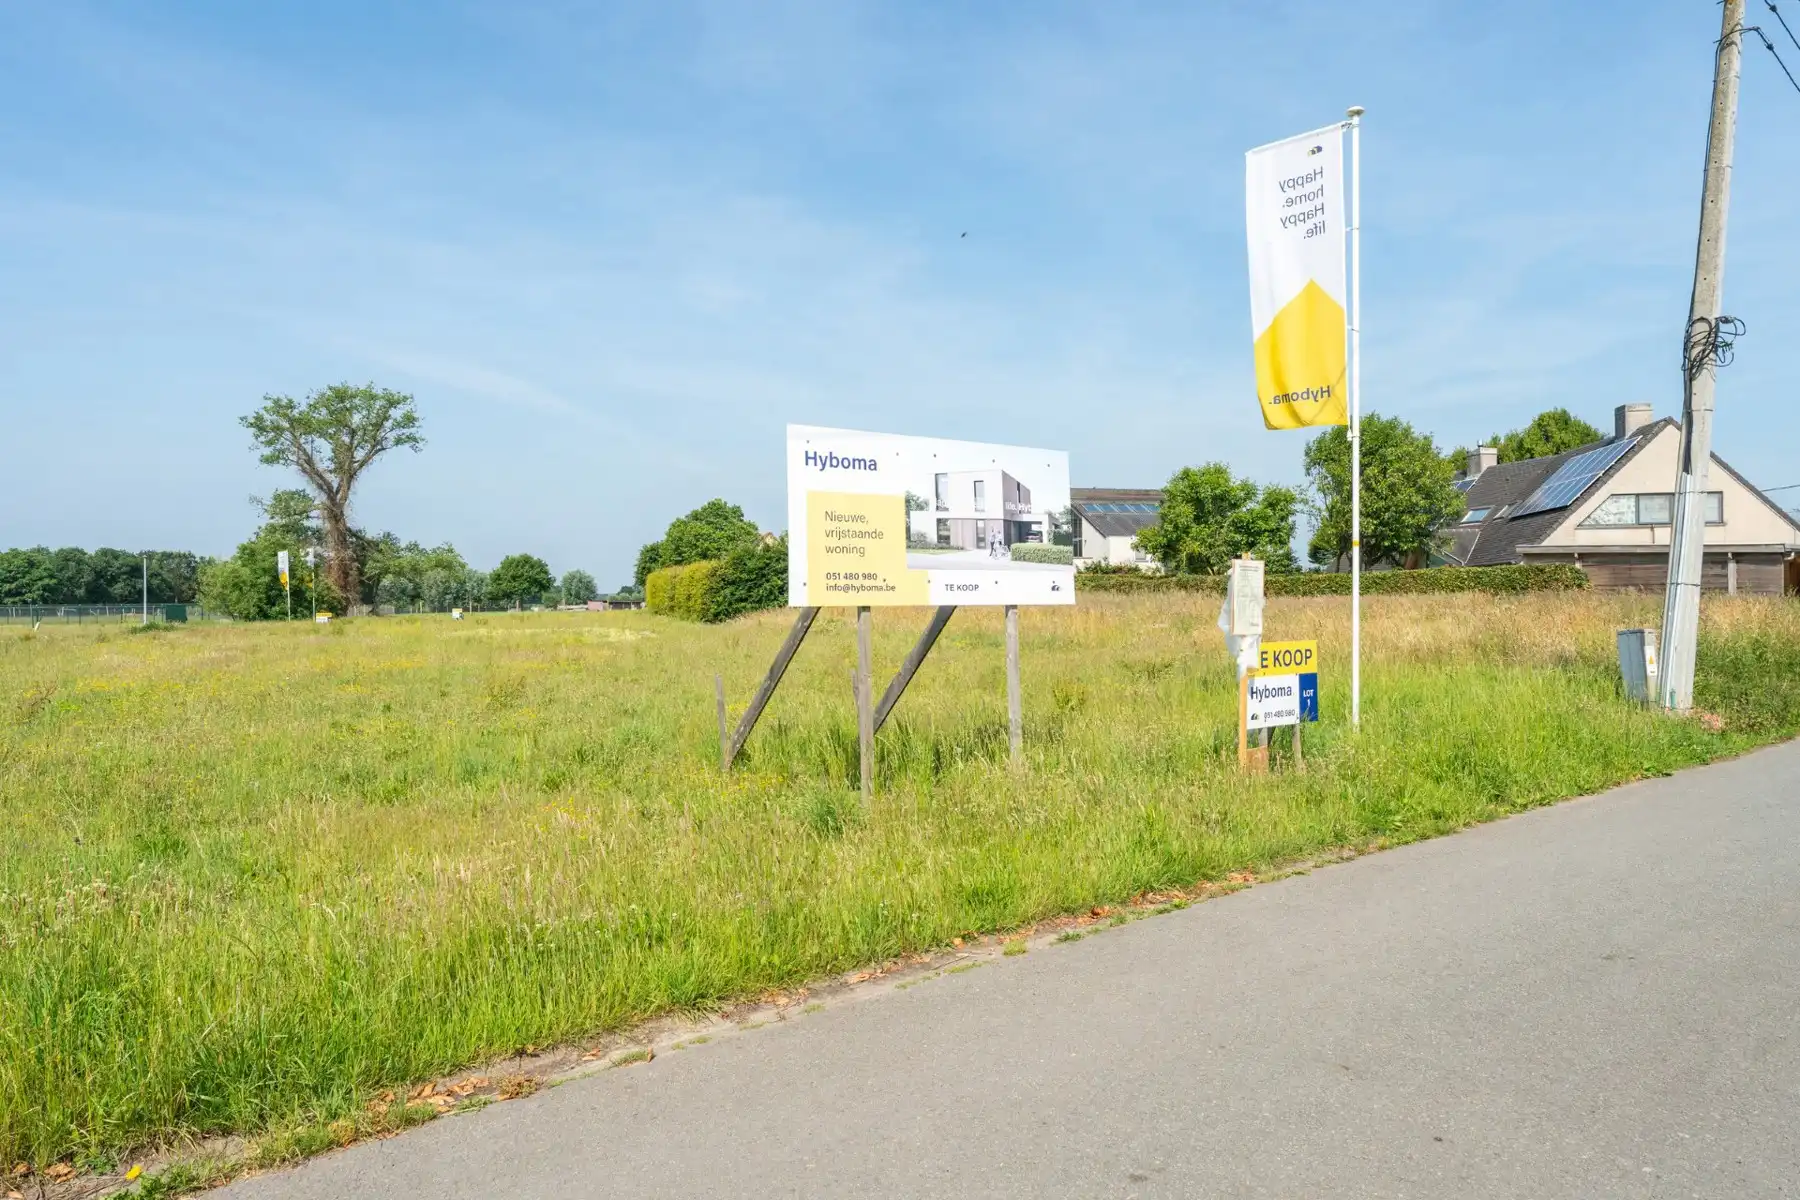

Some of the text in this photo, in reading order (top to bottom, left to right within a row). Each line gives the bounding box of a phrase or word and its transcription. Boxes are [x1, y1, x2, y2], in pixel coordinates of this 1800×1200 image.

[804, 450, 878, 471] Hyboma
[824, 510, 869, 524] Nieuwe,
[824, 527, 884, 541] vrijstaande
[825, 544, 865, 557] woning
[826, 572, 878, 581] 051 480 980
[826, 583, 896, 593] info@hyboma.be
[944, 584, 980, 592] TE KOOP
[1260, 648, 1313, 669] E KOOP
[1250, 684, 1292, 703] Hyboma
[1303, 689, 1314, 698] LOT
[1263, 709, 1296, 719] 051 480 980
